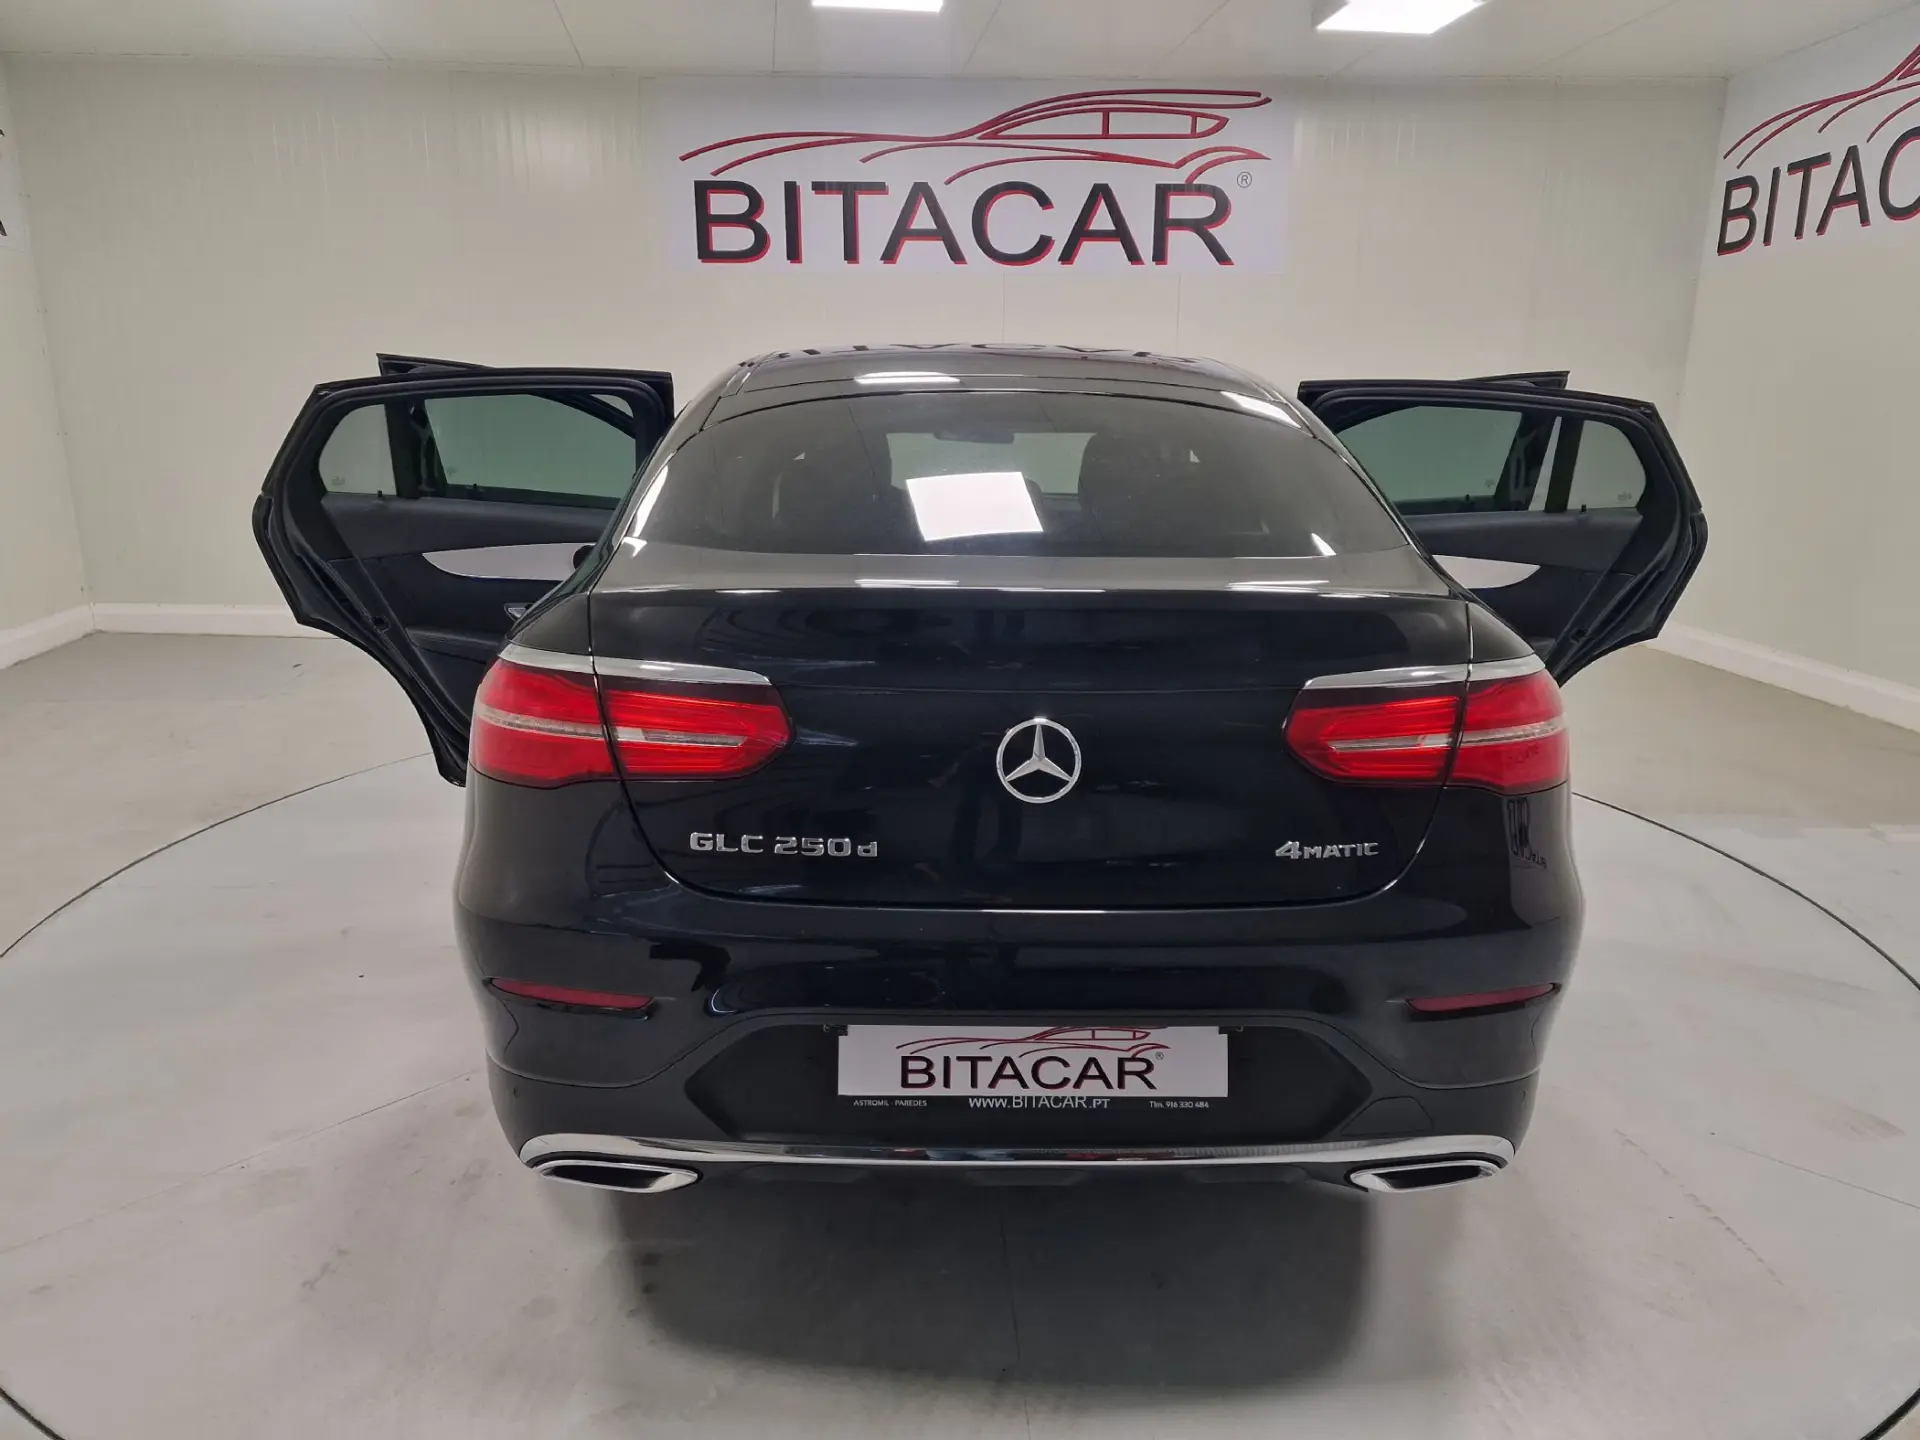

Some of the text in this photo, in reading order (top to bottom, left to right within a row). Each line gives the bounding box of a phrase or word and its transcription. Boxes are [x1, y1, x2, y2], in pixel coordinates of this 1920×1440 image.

[693, 178, 1234, 267] BITACAR
[689, 831, 764, 853] GLC
[1275, 840, 1379, 860] 4MATIC
[900, 1055, 1157, 1090] BITACAR
[894, 1099, 928, 1107] PAREDES
